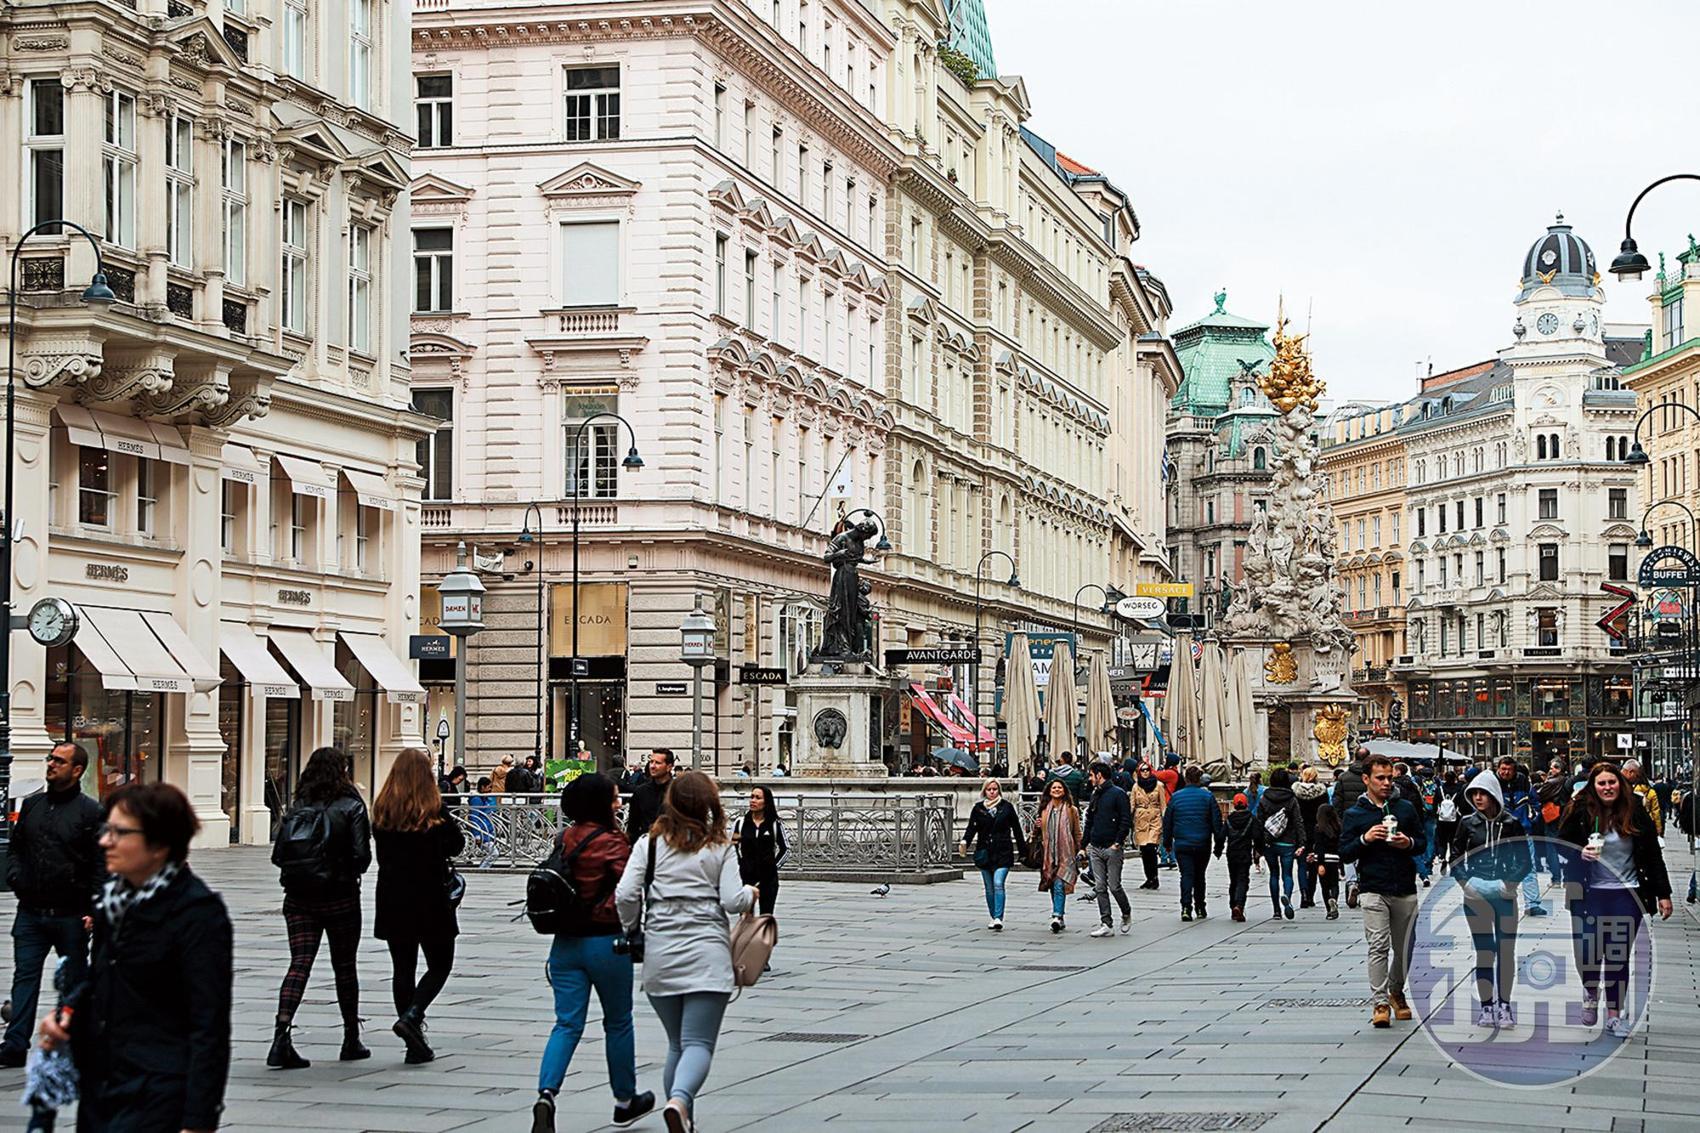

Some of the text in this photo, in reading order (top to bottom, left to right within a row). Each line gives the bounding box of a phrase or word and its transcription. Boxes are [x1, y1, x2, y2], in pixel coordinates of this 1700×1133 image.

[1653, 570, 1688, 579] BUFFET
[1141, 586, 1187, 594] VERSACE
[445, 605, 466, 613] DAMEN
[1122, 601, 1158, 610] WORSEG
[564, 615, 612, 625] ECADA
[906, 650, 977, 660] AVANTGARDE
[743, 672, 782, 680] ESCADA
